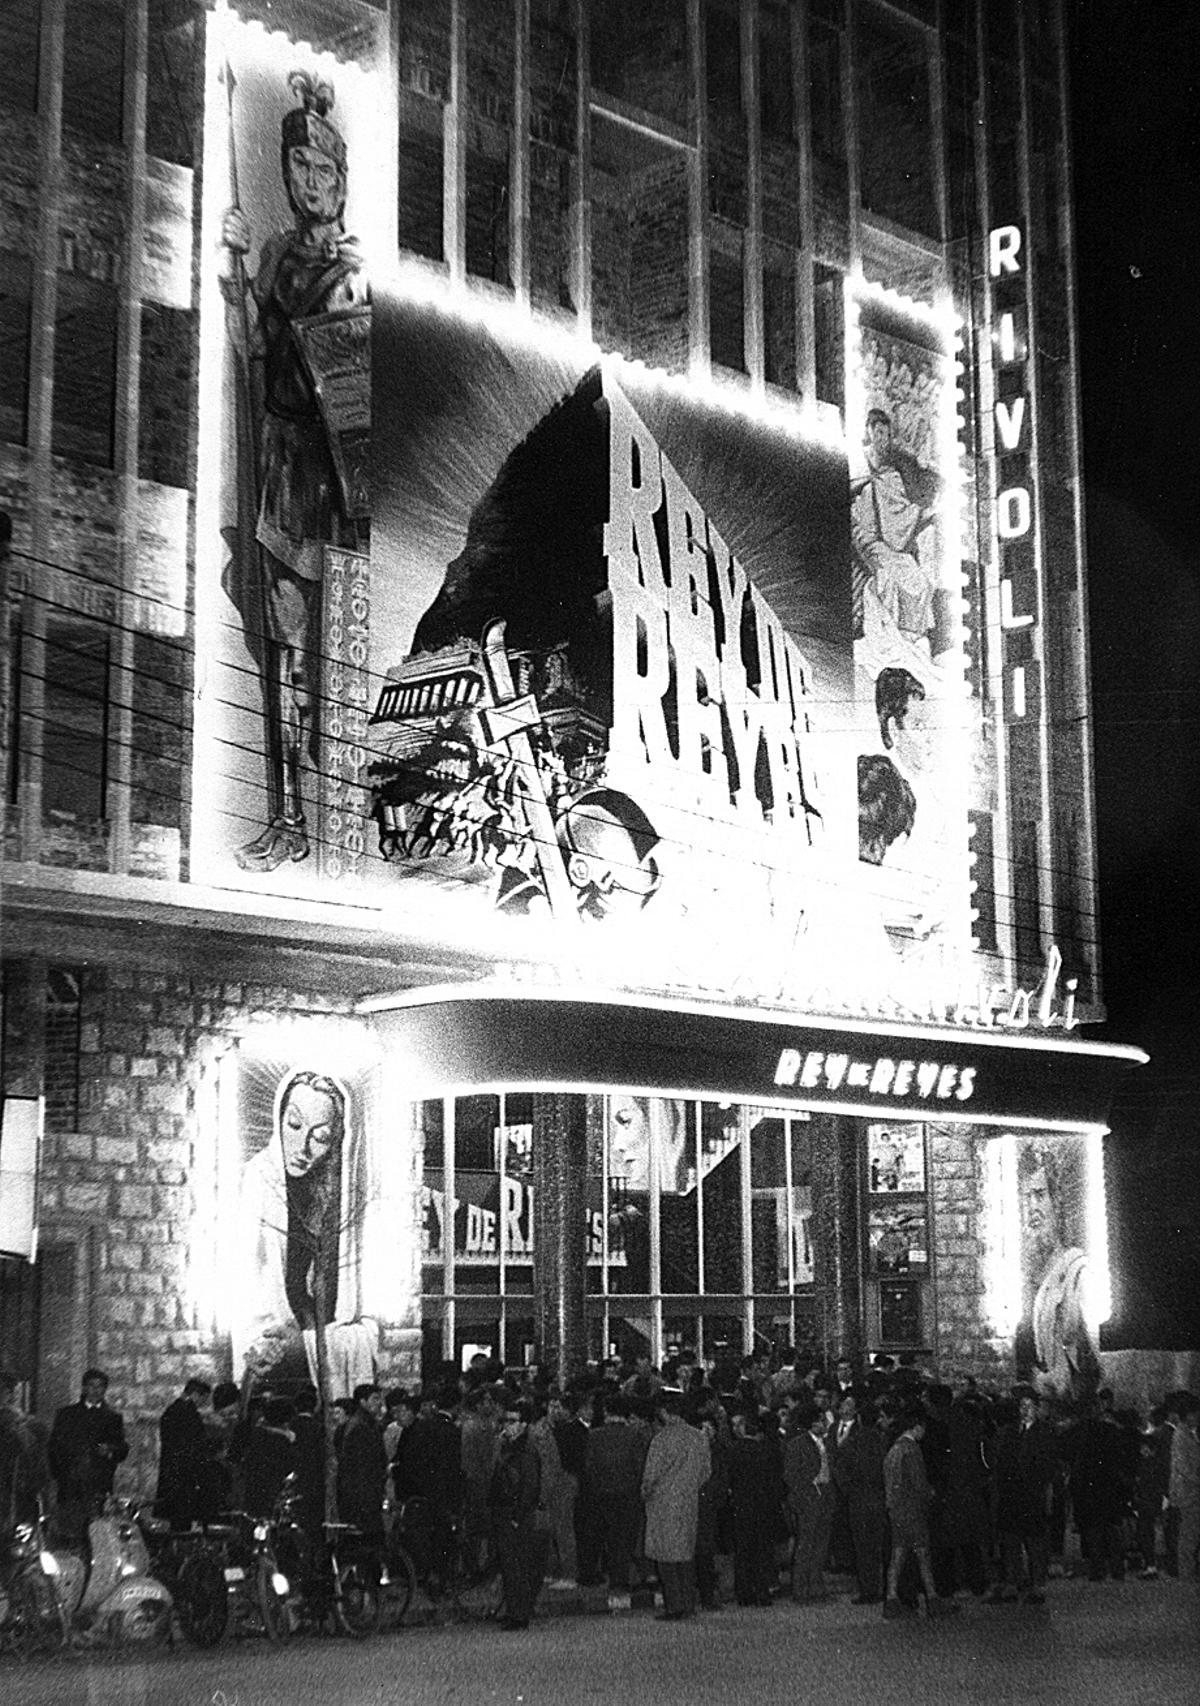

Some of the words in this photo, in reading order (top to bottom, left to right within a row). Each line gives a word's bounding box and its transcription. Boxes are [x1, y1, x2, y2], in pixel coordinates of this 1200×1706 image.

[603, 366, 749, 690] REY
[989, 224, 1036, 717] RIVOLI
[603, 590, 828, 848] REYES
[773, 1048, 849, 1091] REY
[868, 1057, 977, 1101] REYES
[466, 1202, 497, 1251] DE
